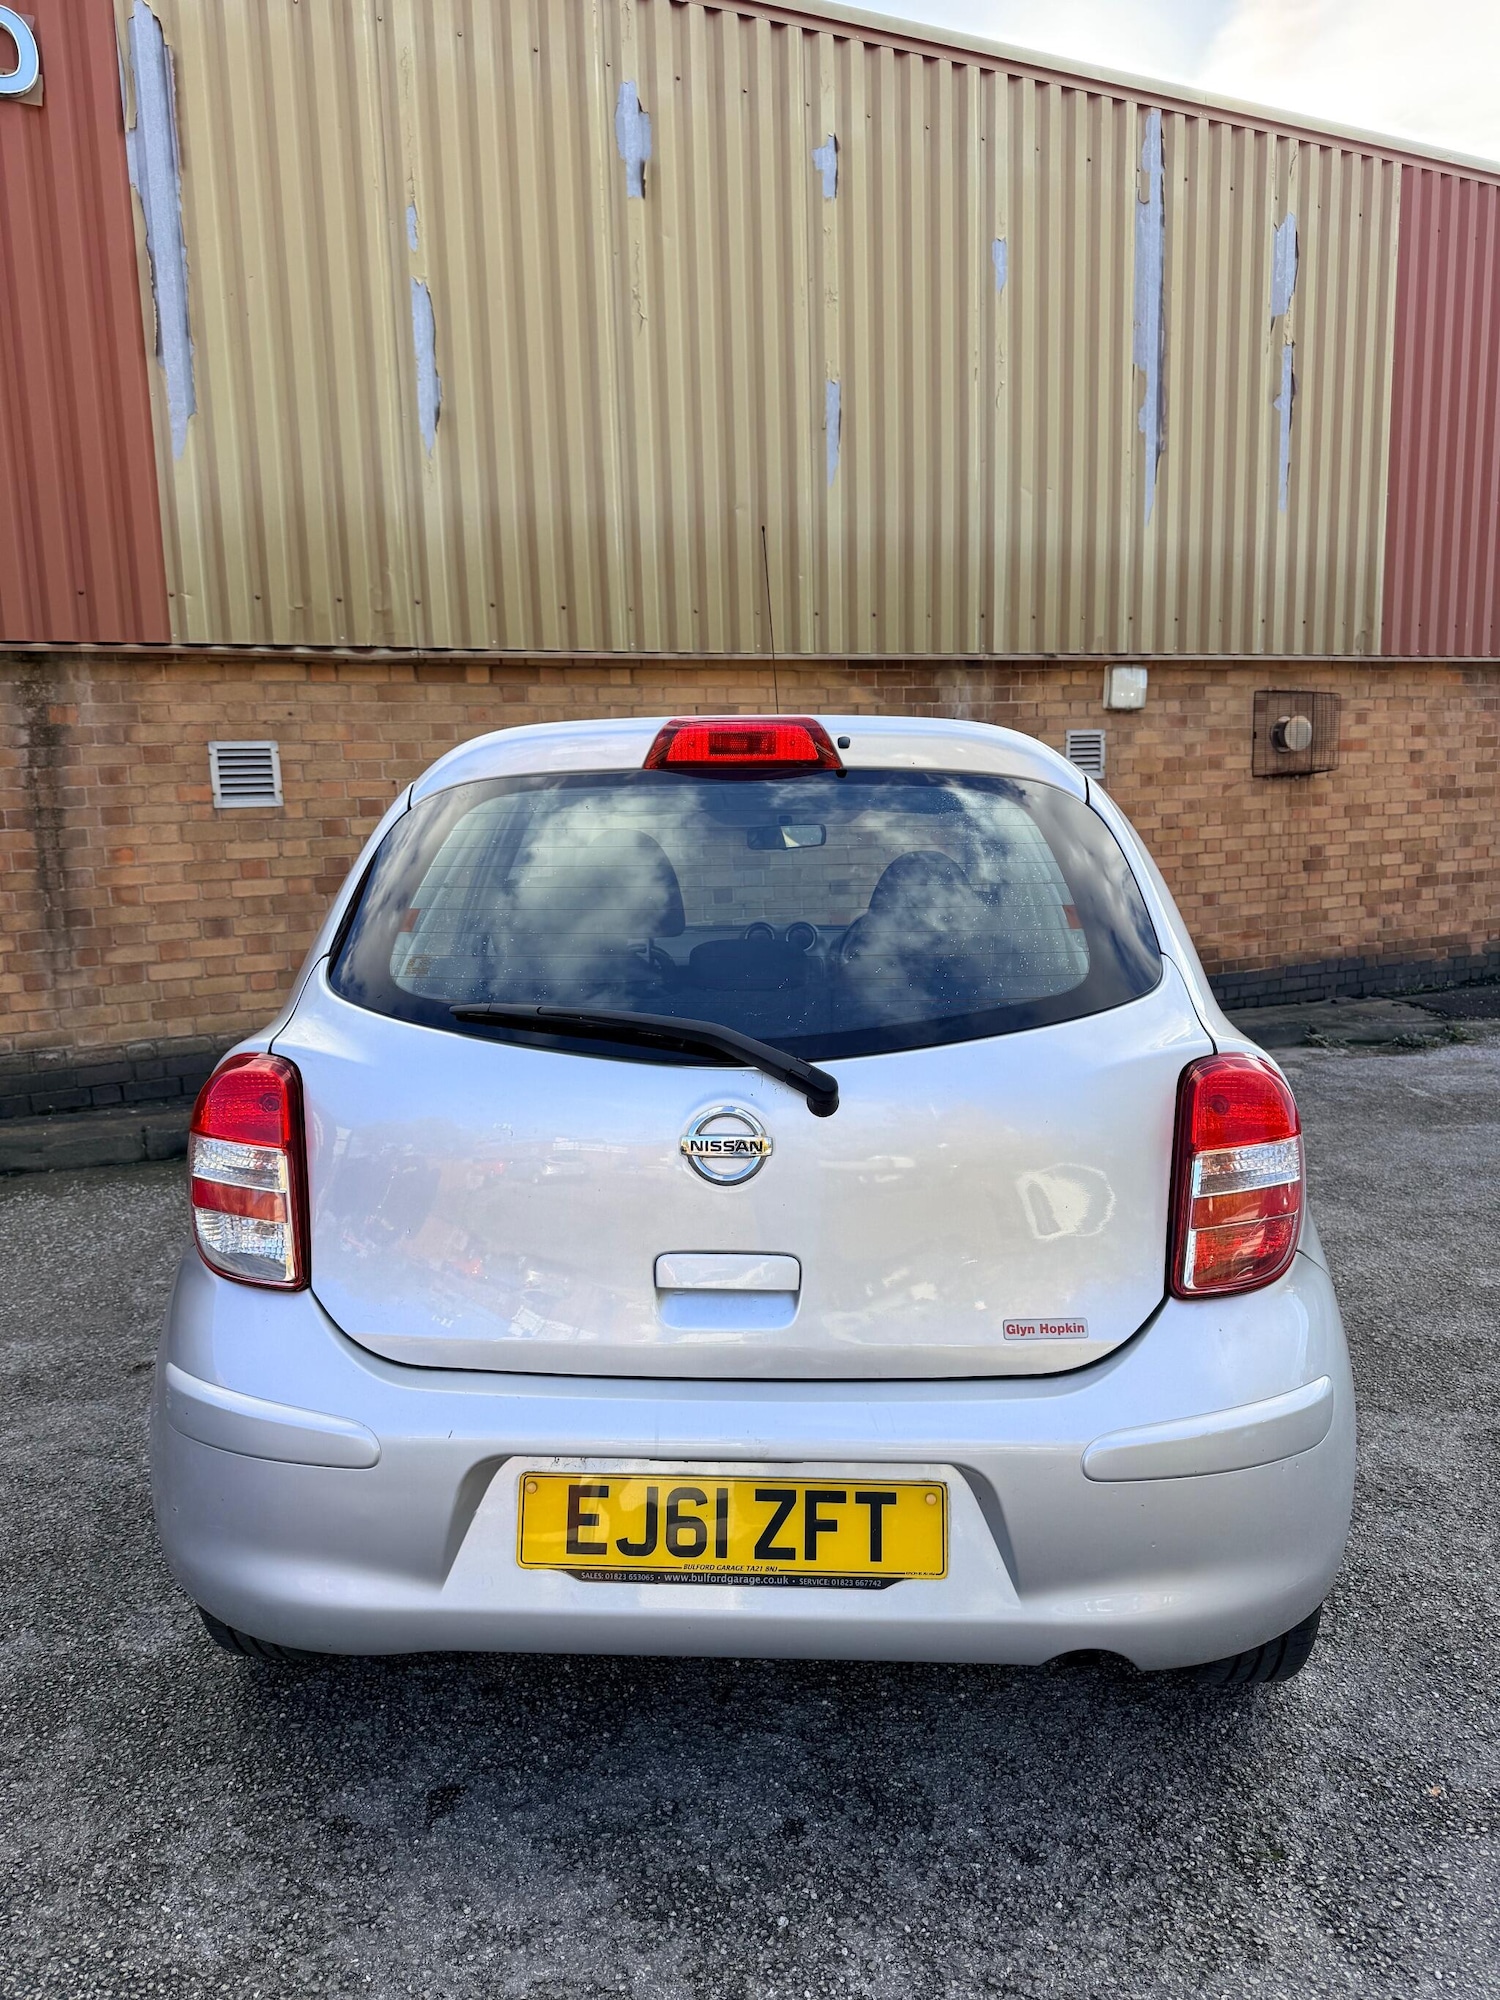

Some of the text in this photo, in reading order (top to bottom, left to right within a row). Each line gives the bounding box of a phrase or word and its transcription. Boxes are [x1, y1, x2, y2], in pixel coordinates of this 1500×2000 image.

[690, 1140, 763, 1152] NISSAN
[1006, 1323, 1085, 1336] Glyn Hopkin
[566, 1484, 897, 1562] EJ61 ZFT
[683, 1563, 715, 1571] BULFORD
[581, 1572, 604, 1580] SALES:
[664, 1573, 789, 1585] www.bulfordgarage.co.uk
[799, 1578, 830, 1586] SERVICE:
[831, 1579, 854, 1587] 01823
